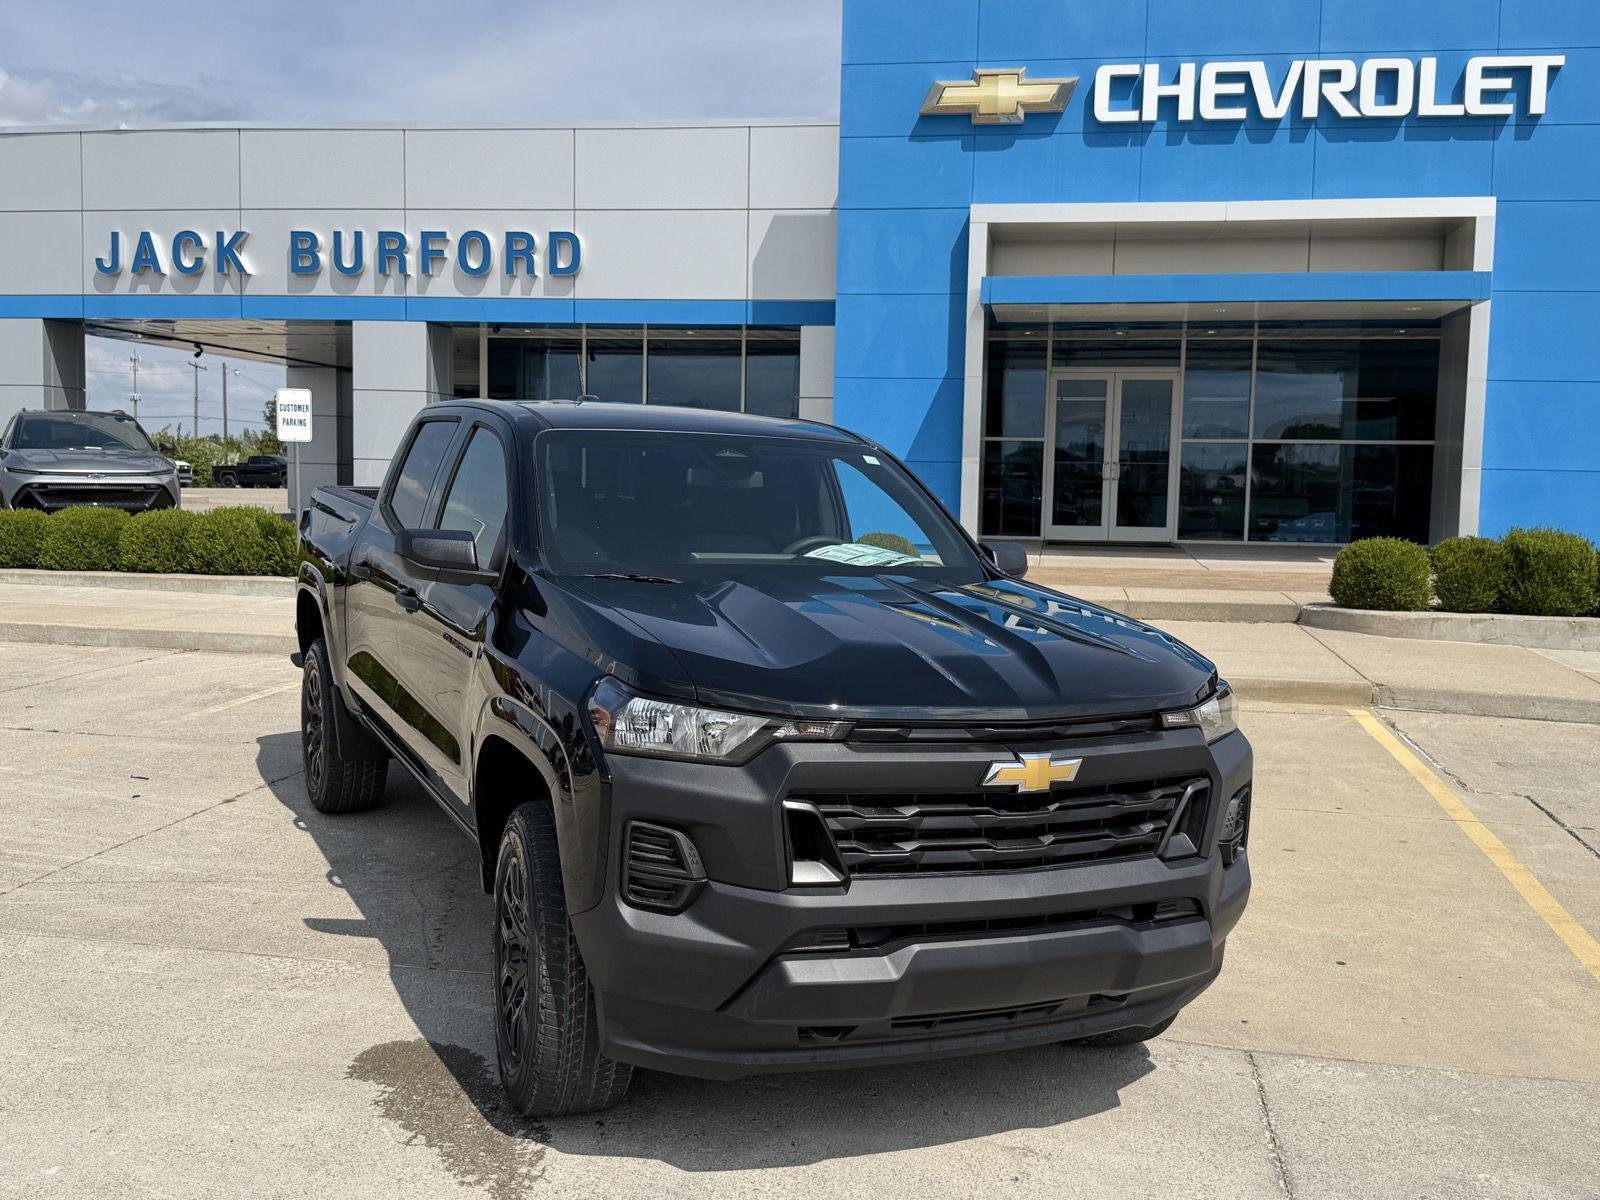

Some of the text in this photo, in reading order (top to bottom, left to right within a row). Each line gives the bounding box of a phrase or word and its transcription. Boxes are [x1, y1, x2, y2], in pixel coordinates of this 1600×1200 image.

[1093, 54, 1565, 122] CHEVROLET
[95, 230, 582, 277] JACK BURFORD
[279, 403, 310, 413] CUSTOMER
[282, 417, 307, 427] PARKING
